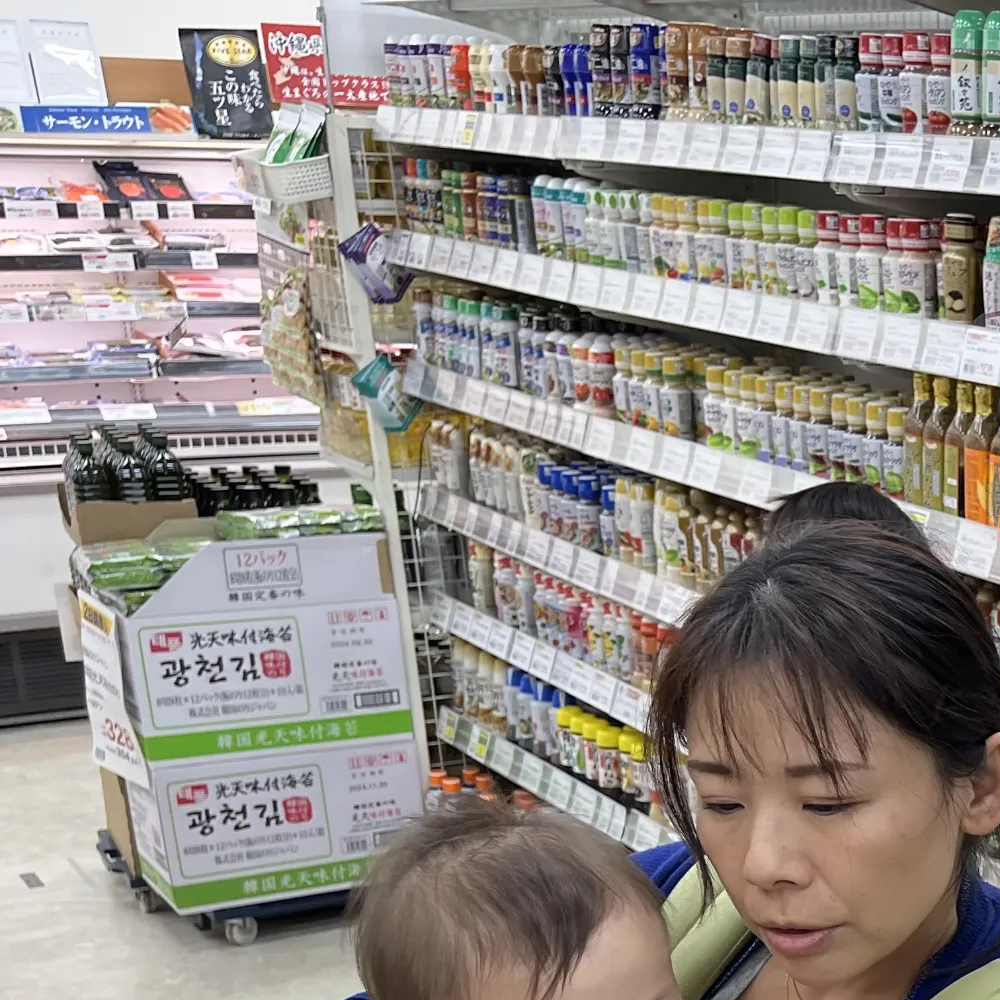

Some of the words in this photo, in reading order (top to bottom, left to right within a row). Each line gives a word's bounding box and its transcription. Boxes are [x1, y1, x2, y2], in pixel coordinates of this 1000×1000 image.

[268, 31, 323, 55] 沖縄県
[209, 80, 232, 126] 五ツ星
[224, 69, 243, 106] この味
[957, 76, 973, 111] 叙々苑
[42, 114, 144, 130] サーモン・トラウト
[236, 550, 287, 568] 12パック
[228, 588, 305, 603] 韓国定番の味
[159, 652, 261, 687] 광천김
[216, 720, 359, 750] 韓国光天味付海苔
[186, 799, 285, 837] 광천김
